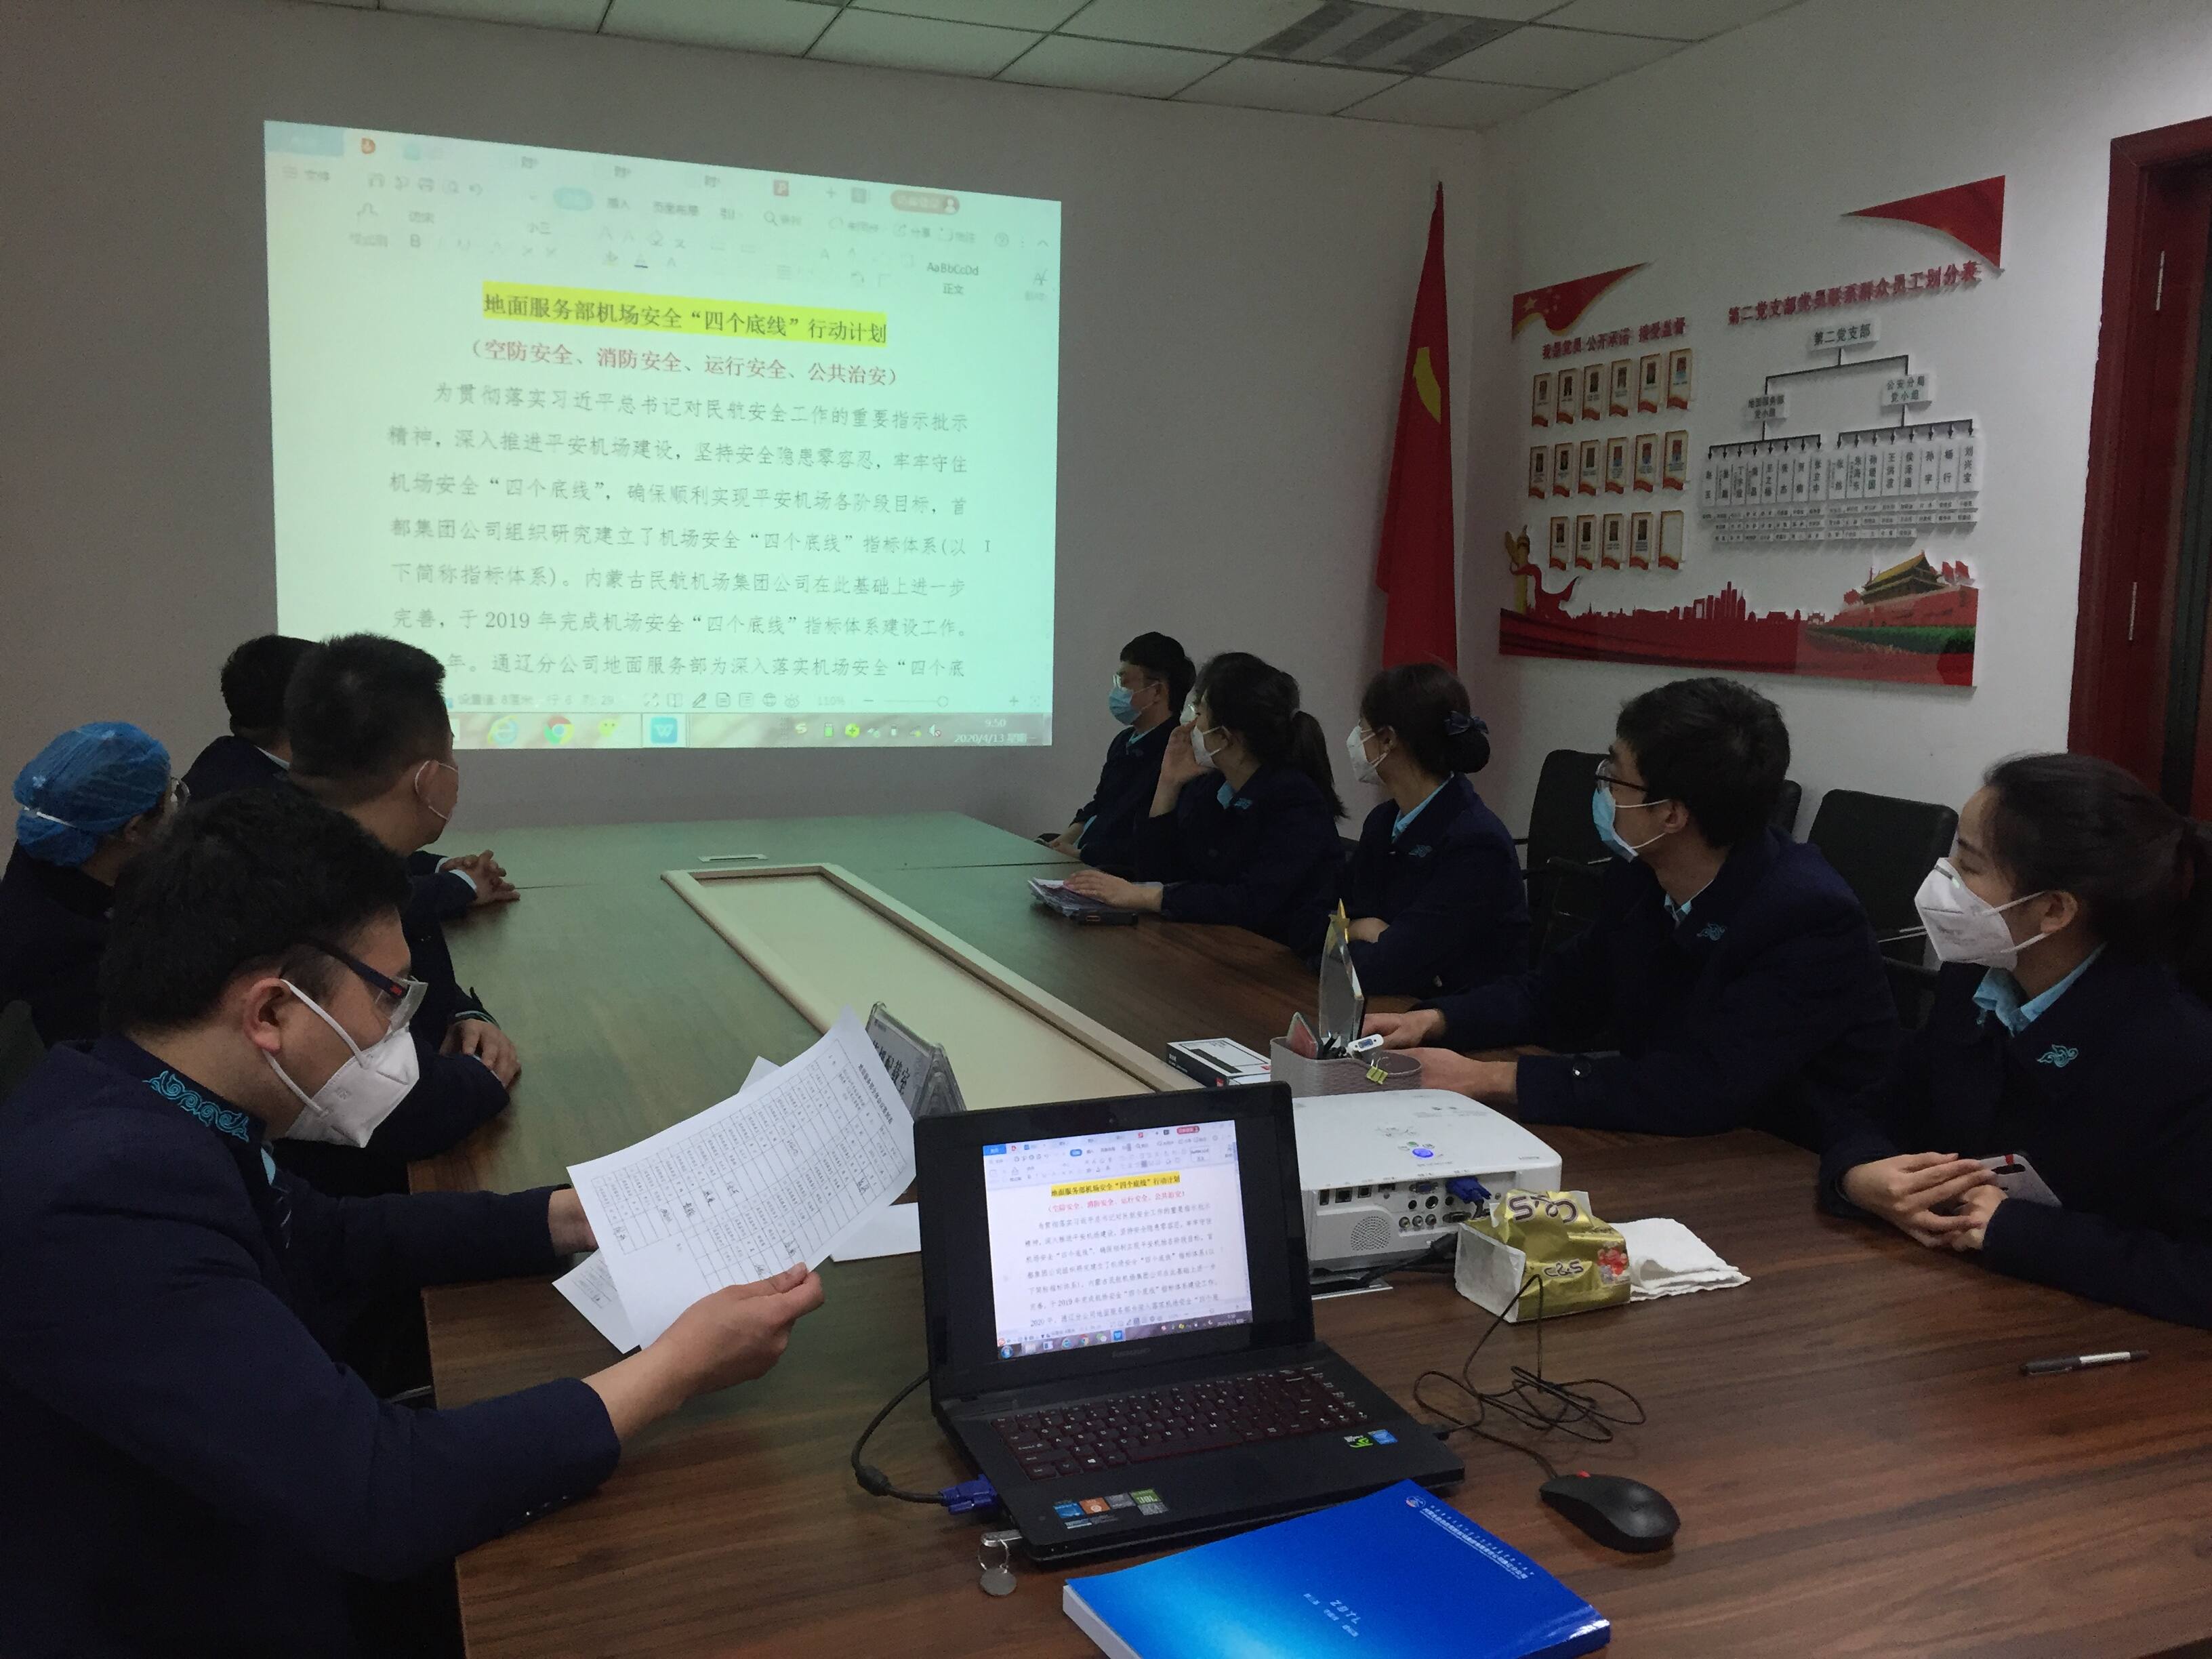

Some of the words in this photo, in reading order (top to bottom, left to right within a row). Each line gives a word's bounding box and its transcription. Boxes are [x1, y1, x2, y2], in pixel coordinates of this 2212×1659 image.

[926, 262, 979, 276] AaBbCcDd
[943, 283, 964, 295] 正文
[484, 293, 887, 344] 地面服务部机场安全“四个底线”行动计划
[1814, 323, 1871, 346] 第二党支部
[954, 733, 1004, 743] 2020/4/13
[1544, 1258, 1584, 1277] C&S
